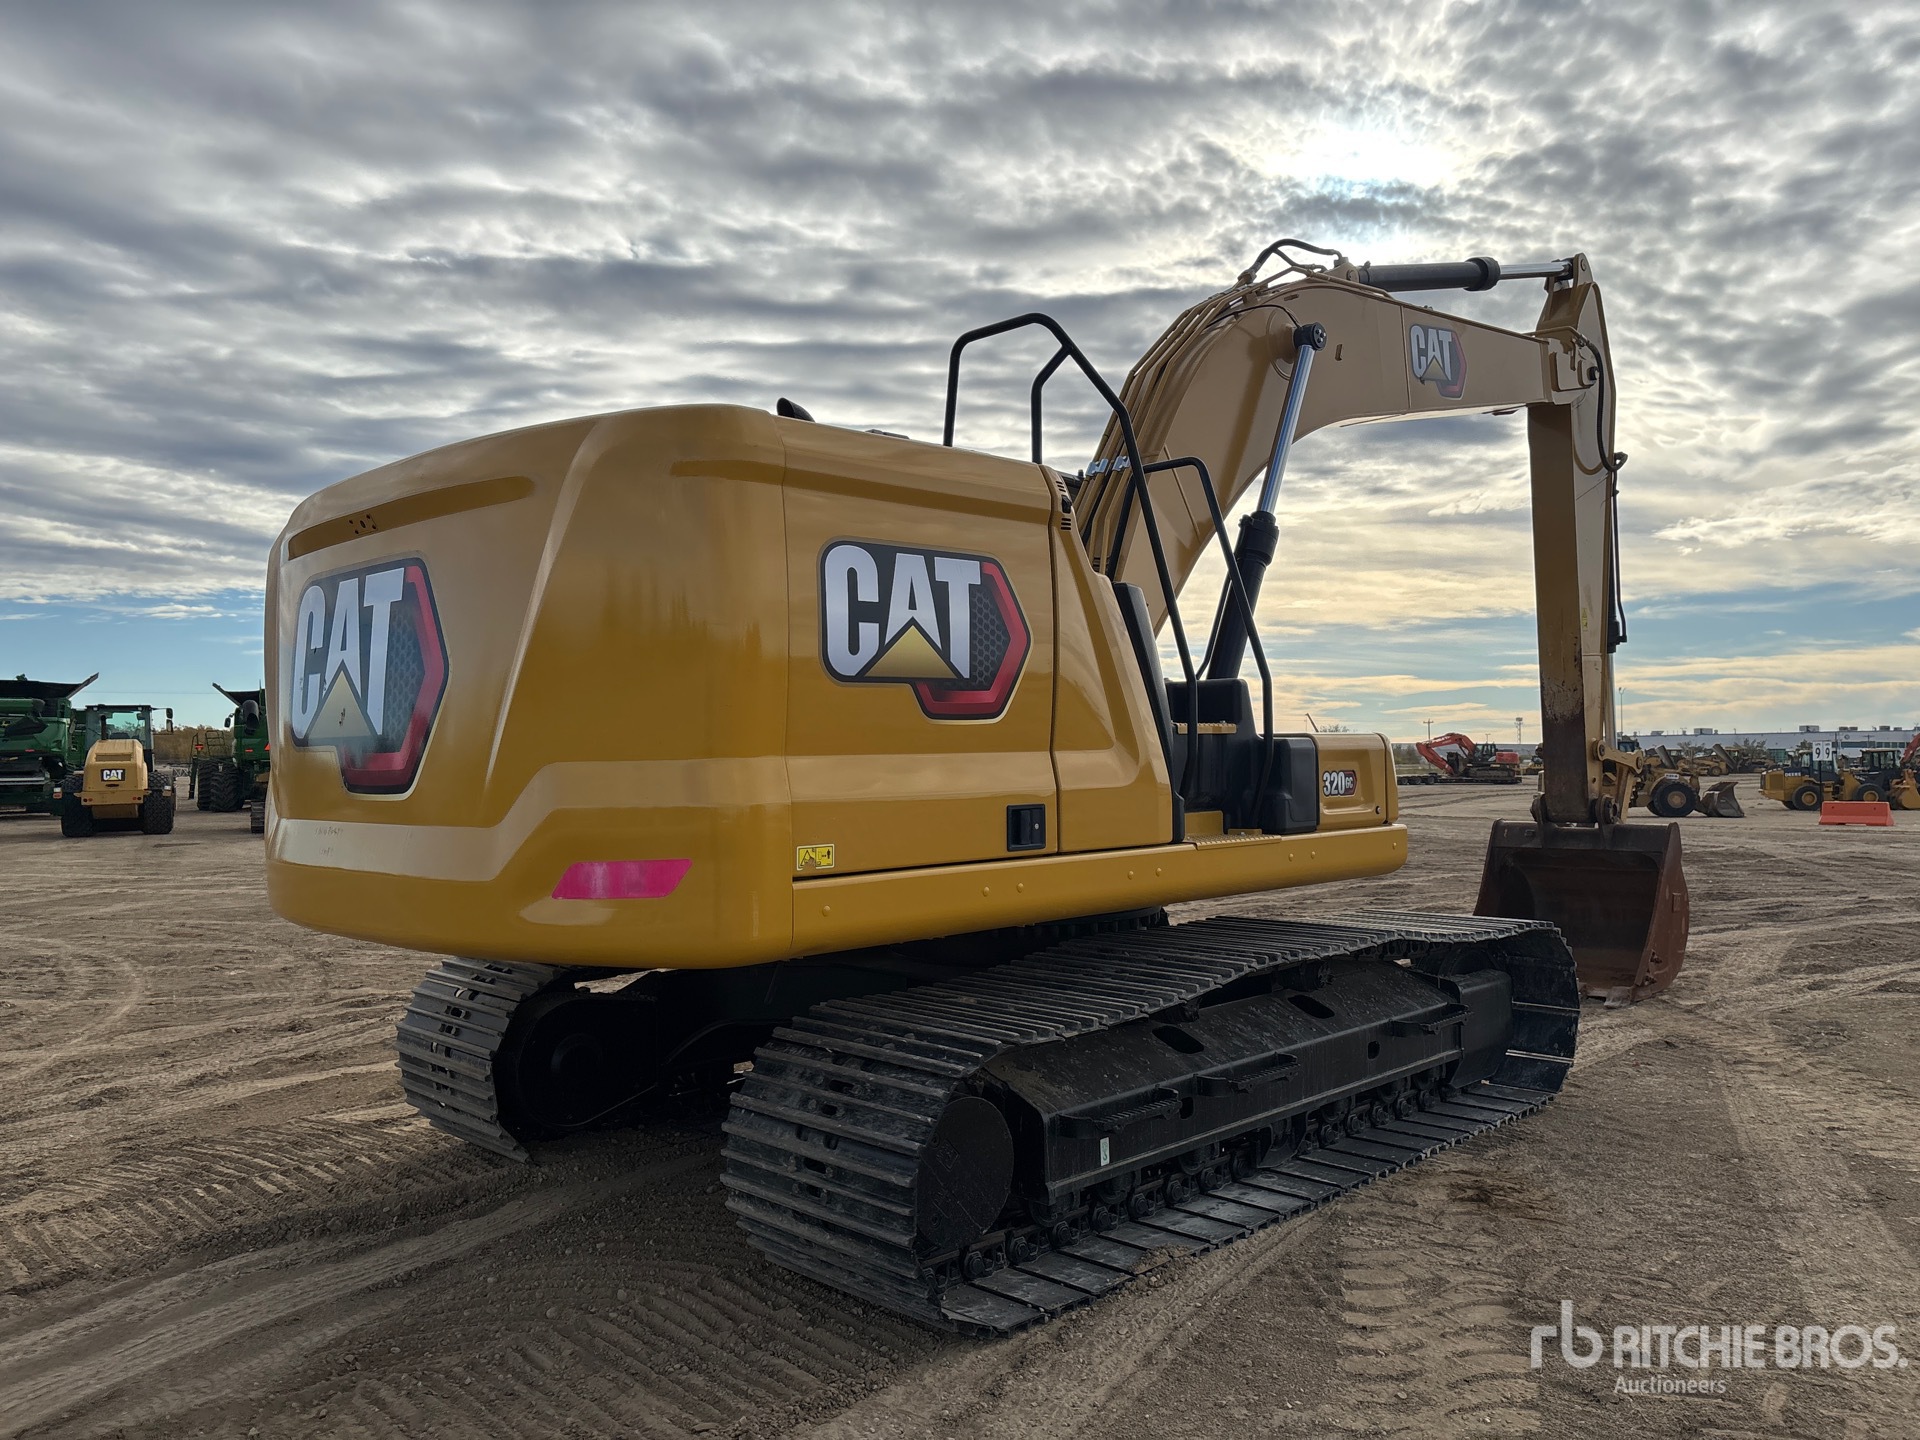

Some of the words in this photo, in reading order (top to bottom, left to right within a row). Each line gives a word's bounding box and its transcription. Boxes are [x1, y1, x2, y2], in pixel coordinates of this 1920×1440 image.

[1410, 325, 1452, 380] CAT
[825, 544, 981, 679] CAT
[291, 567, 405, 739] CAT
[103, 769, 123, 781] CAT
[1323, 771, 1345, 795] 320
